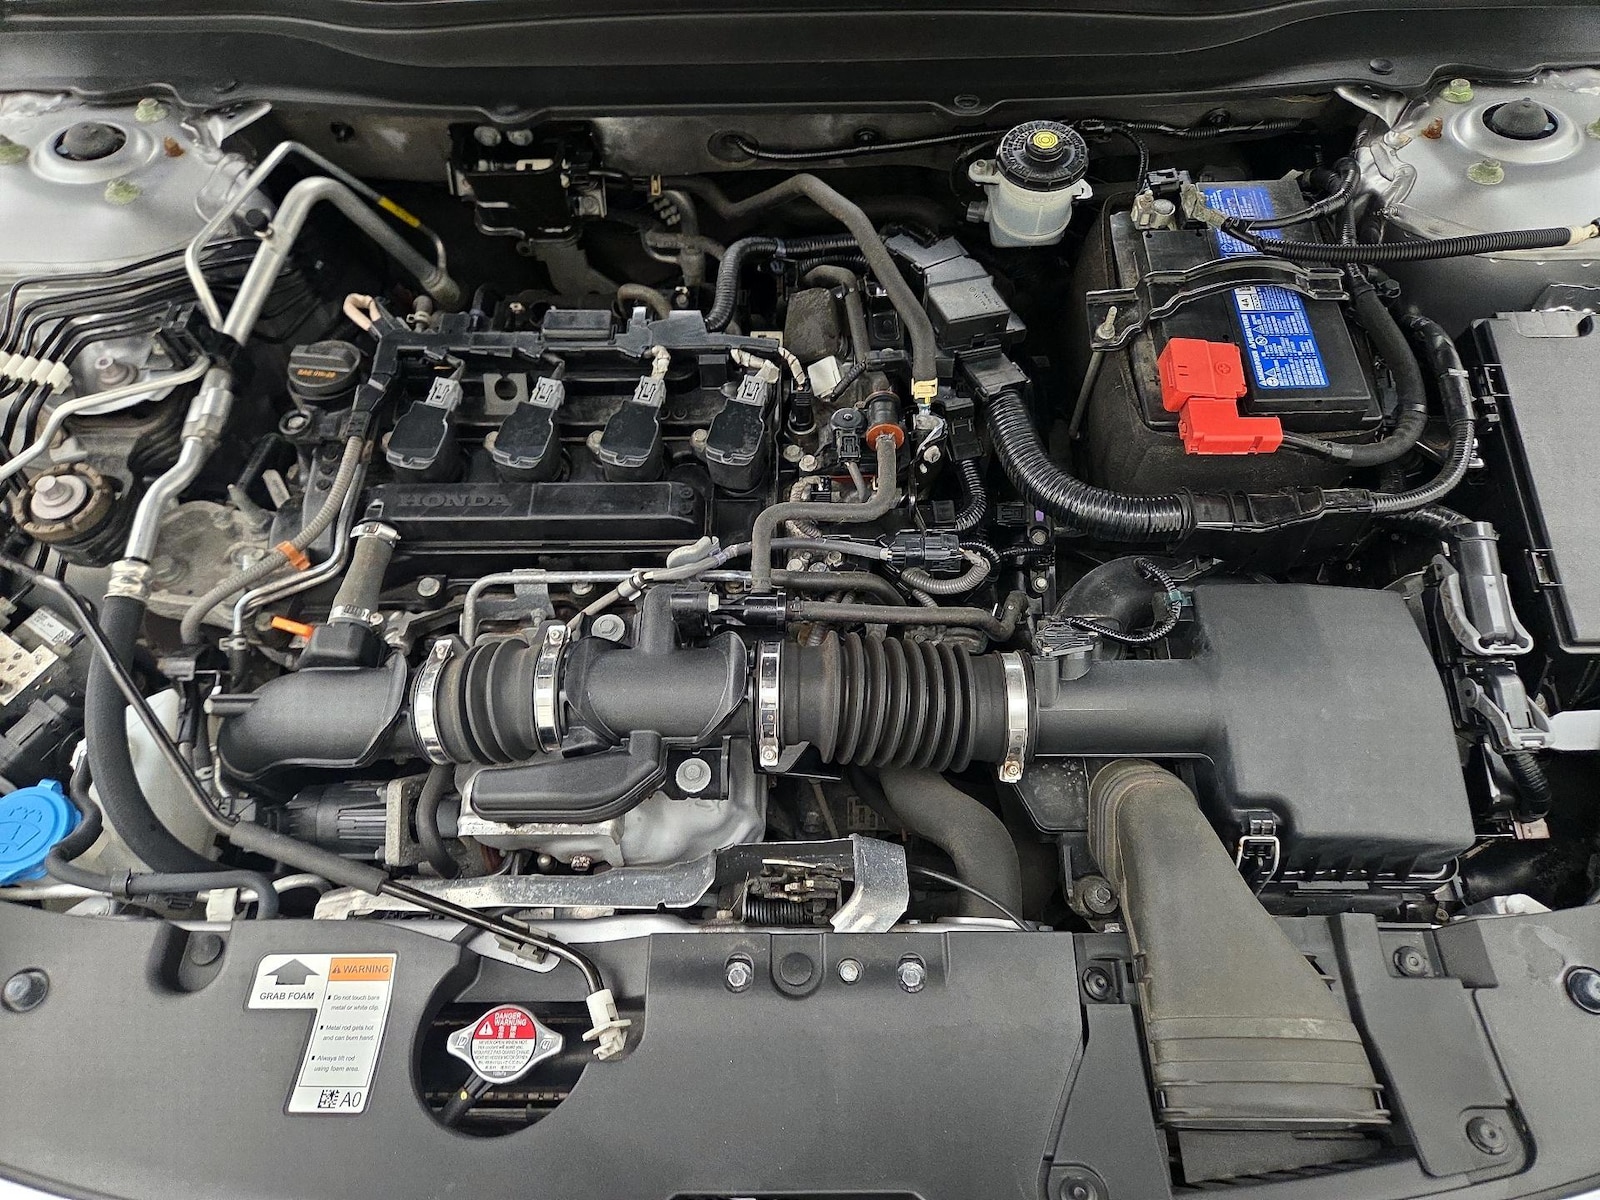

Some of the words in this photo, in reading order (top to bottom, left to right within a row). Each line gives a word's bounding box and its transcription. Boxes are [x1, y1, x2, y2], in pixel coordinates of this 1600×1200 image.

[1241, 298, 1250, 307] 4A
[398, 493, 513, 507] HONDA
[343, 965, 389, 974] WARNING
[259, 992, 286, 1000] GRAB
[287, 992, 315, 1000] FOAM
[494, 1012, 522, 1020] DANGER
[316, 1055, 337, 1063] Always
[313, 1065, 330, 1073] using
[339, 1091, 362, 1108] A0
